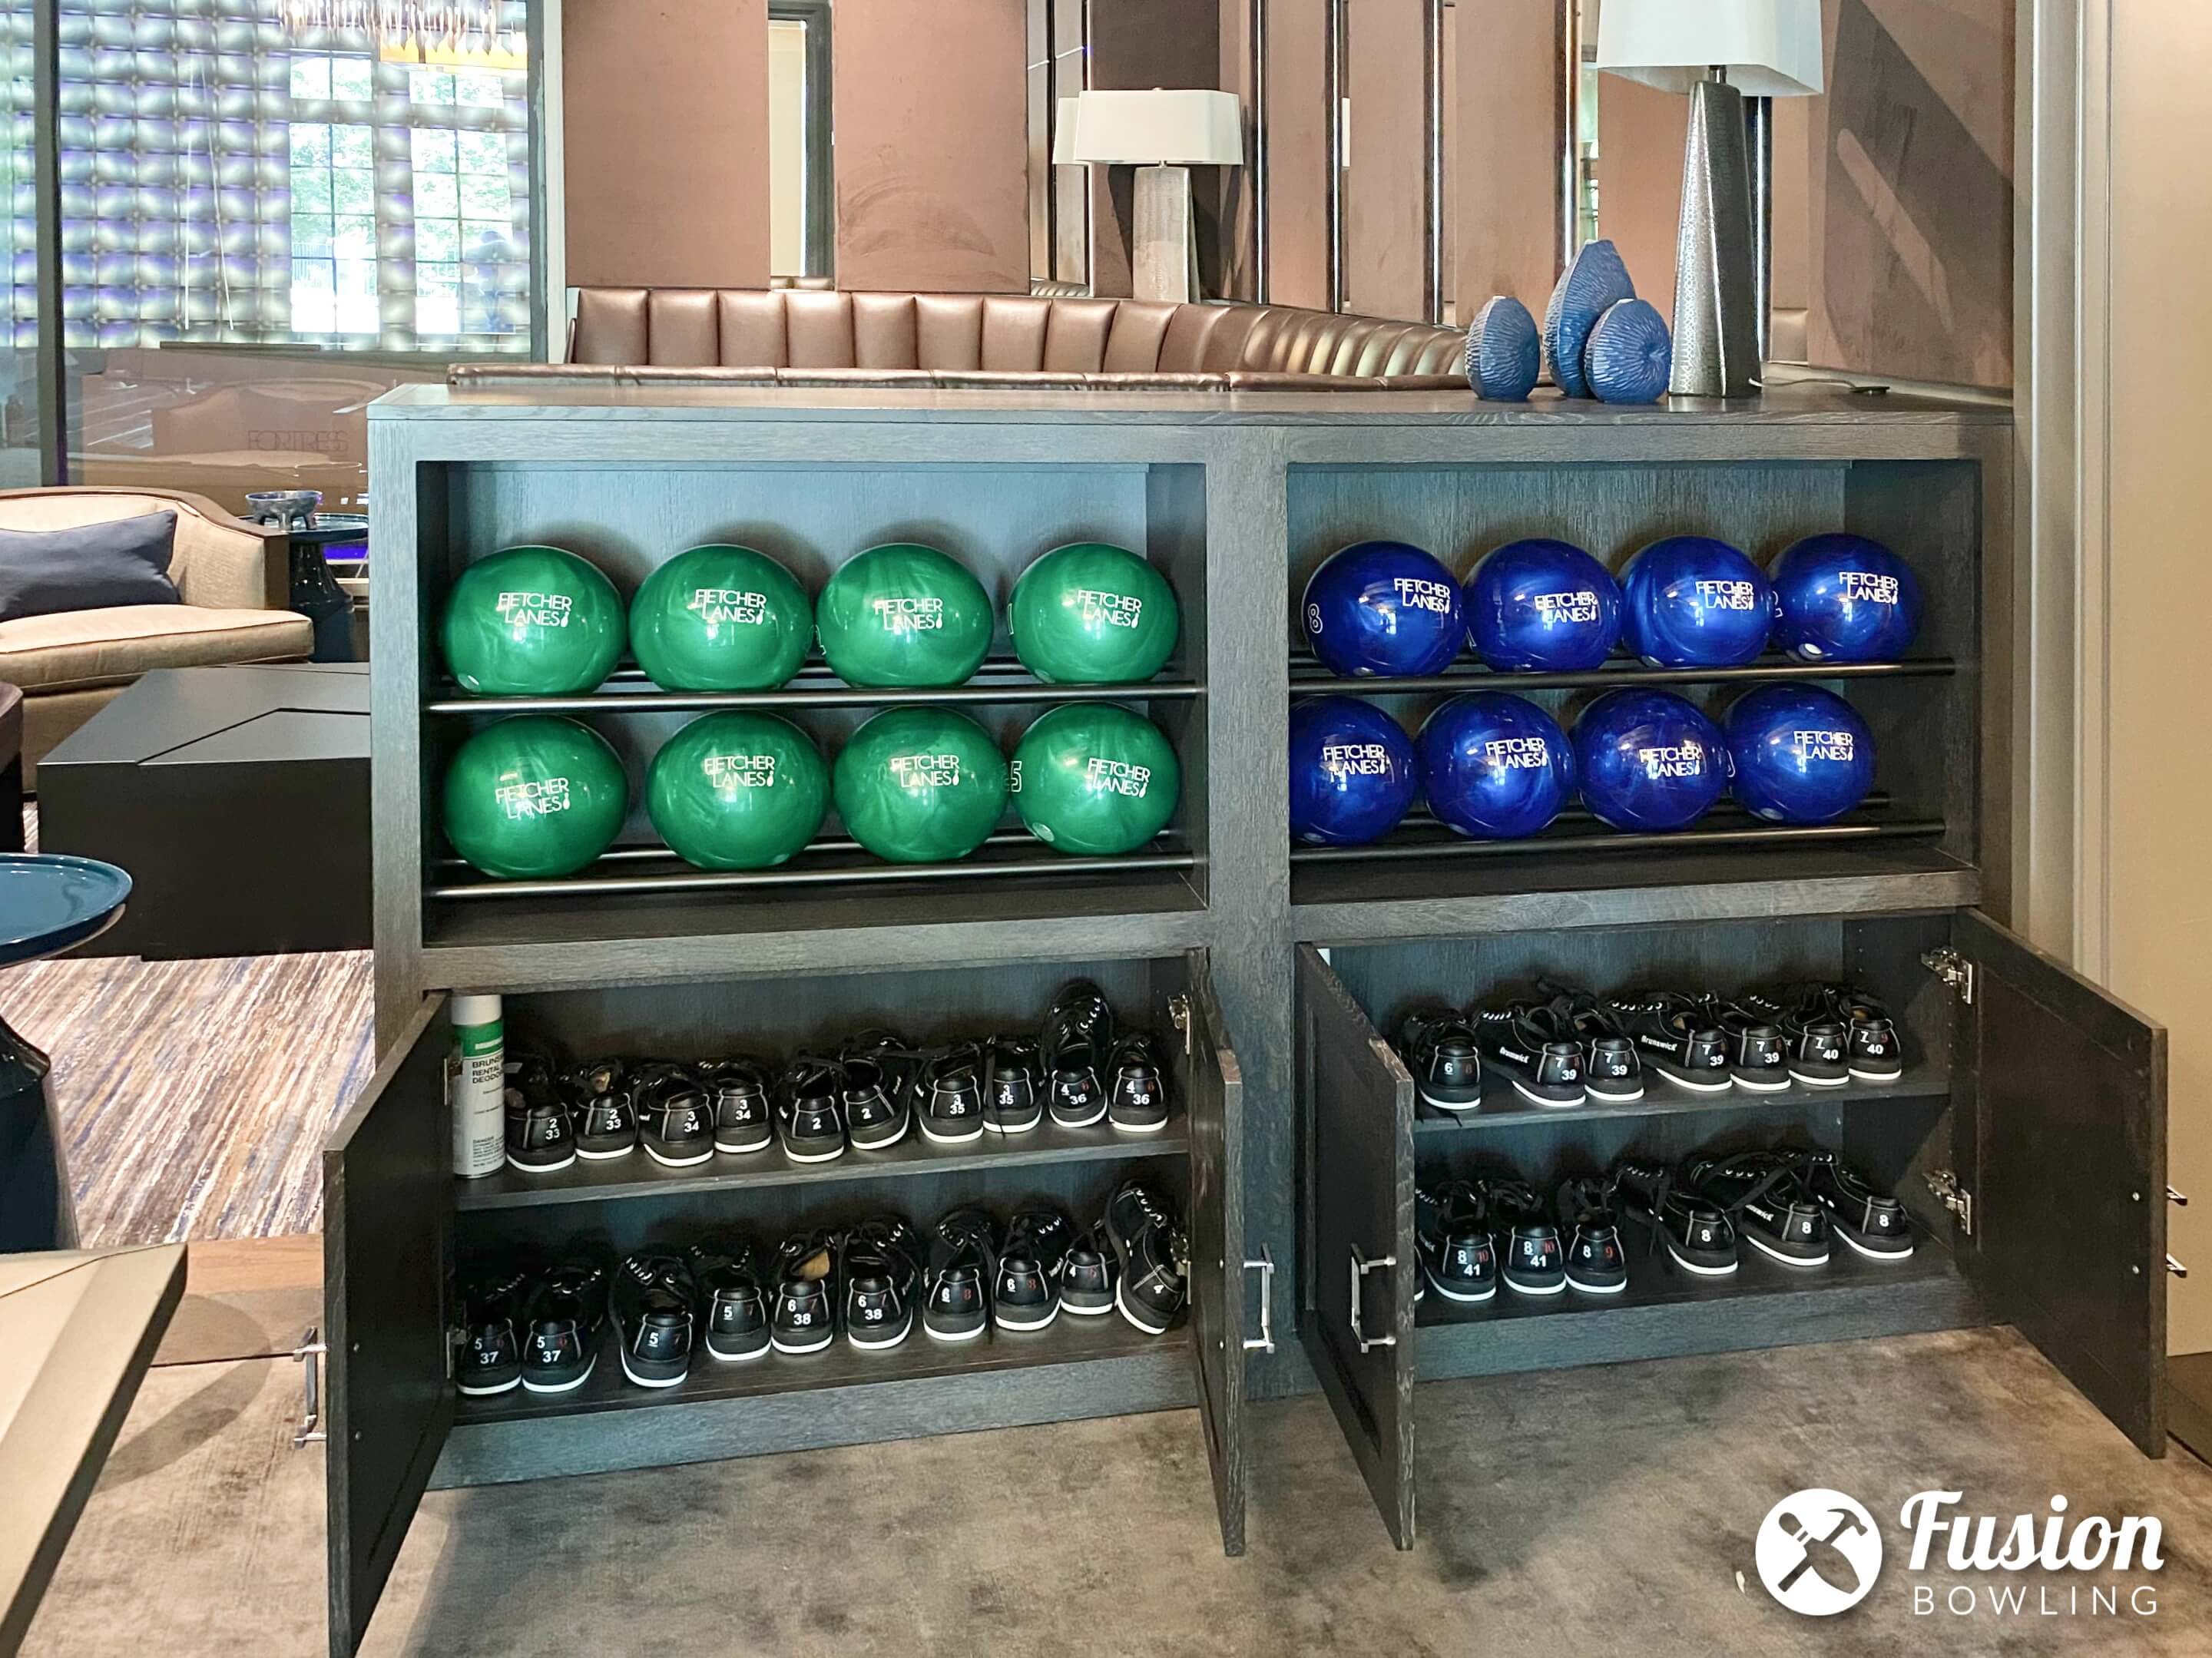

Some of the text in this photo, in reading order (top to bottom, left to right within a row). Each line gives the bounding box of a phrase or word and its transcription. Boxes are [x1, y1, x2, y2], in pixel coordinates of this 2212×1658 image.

[1847, 586, 1892, 602] LANES
[1402, 594, 1444, 612] LANES
[1705, 594, 1748, 609] LANES
[505, 609, 560, 626] LANES
[701, 604, 757, 624] LANES
[1084, 607, 1131, 627] LANES
[1308, 604, 1323, 634] 8
[1544, 606, 1591, 623] LANES
[884, 613, 935, 630] LANES
[1803, 746, 1847, 761] LANES
[1332, 758, 1379, 775] LANES
[1495, 752, 1541, 769] LANES
[1011, 760, 1022, 793] 5
[1648, 761, 1694, 779] LANES
[713, 770, 765, 787] LANES
[901, 769, 951, 787] LANES
[1093, 776, 1139, 796] LANES
[507, 796, 562, 819] LANES
[1641, 1035, 1677, 1051] Brunswick
[1702, 1044, 1711, 1055] 7
[1757, 1041, 1765, 1052] 7
[1867, 1044, 1884, 1054] 40
[1499, 1046, 1530, 1064] Brunswick
[1604, 1053, 1613, 1064] 7
[1710, 1055, 1724, 1067] 39
[1764, 1052, 1780, 1064] 39
[1823, 1049, 1839, 1060] 40
[1444, 1062, 1454, 1075] 6
[1555, 1057, 1564, 1068] 7
[1561, 1069, 1577, 1081] 39
[1612, 1065, 1628, 1075] 39
[1003, 1085, 1011, 1095] 3
[1061, 1084, 1070, 1096] 4
[1126, 1081, 1135, 1094] 4
[740, 1100, 747, 1110] 3
[952, 1094, 962, 1105] 3
[998, 1094, 1015, 1105] 35
[1069, 1094, 1087, 1105] 36
[1133, 1094, 1150, 1104] 36
[609, 1109, 618, 1120] 2
[735, 1110, 751, 1120] 34
[862, 1108, 872, 1120] 2
[949, 1104, 965, 1114] 35
[687, 1111, 695, 1121] 3
[549, 1119, 558, 1129] 2
[606, 1119, 621, 1130] 33
[684, 1121, 700, 1133] 34
[813, 1118, 821, 1130] 2
[545, 1129, 560, 1140] 33
[1802, 1221, 1812, 1234] 8
[1879, 1215, 1889, 1227] 8
[1701, 1229, 1711, 1242] 8
[1524, 1241, 1534, 1255] 8
[1583, 1245, 1591, 1258] 8
[1458, 1249, 1467, 1265] 8
[1530, 1255, 1546, 1267] 41
[1464, 1264, 1480, 1276] 41
[1007, 1278, 1015, 1292] 6
[942, 1287, 950, 1302] 6
[787, 1299, 796, 1312] 6
[858, 1296, 866, 1308] 6
[724, 1306, 733, 1320] 5
[793, 1313, 811, 1325] 38
[865, 1309, 882, 1321] 38
[474, 1337, 482, 1350] 5
[537, 1336, 545, 1349] 5
[649, 1332, 659, 1347] 5
[480, 1352, 498, 1365] 37
[542, 1350, 561, 1363] 37
